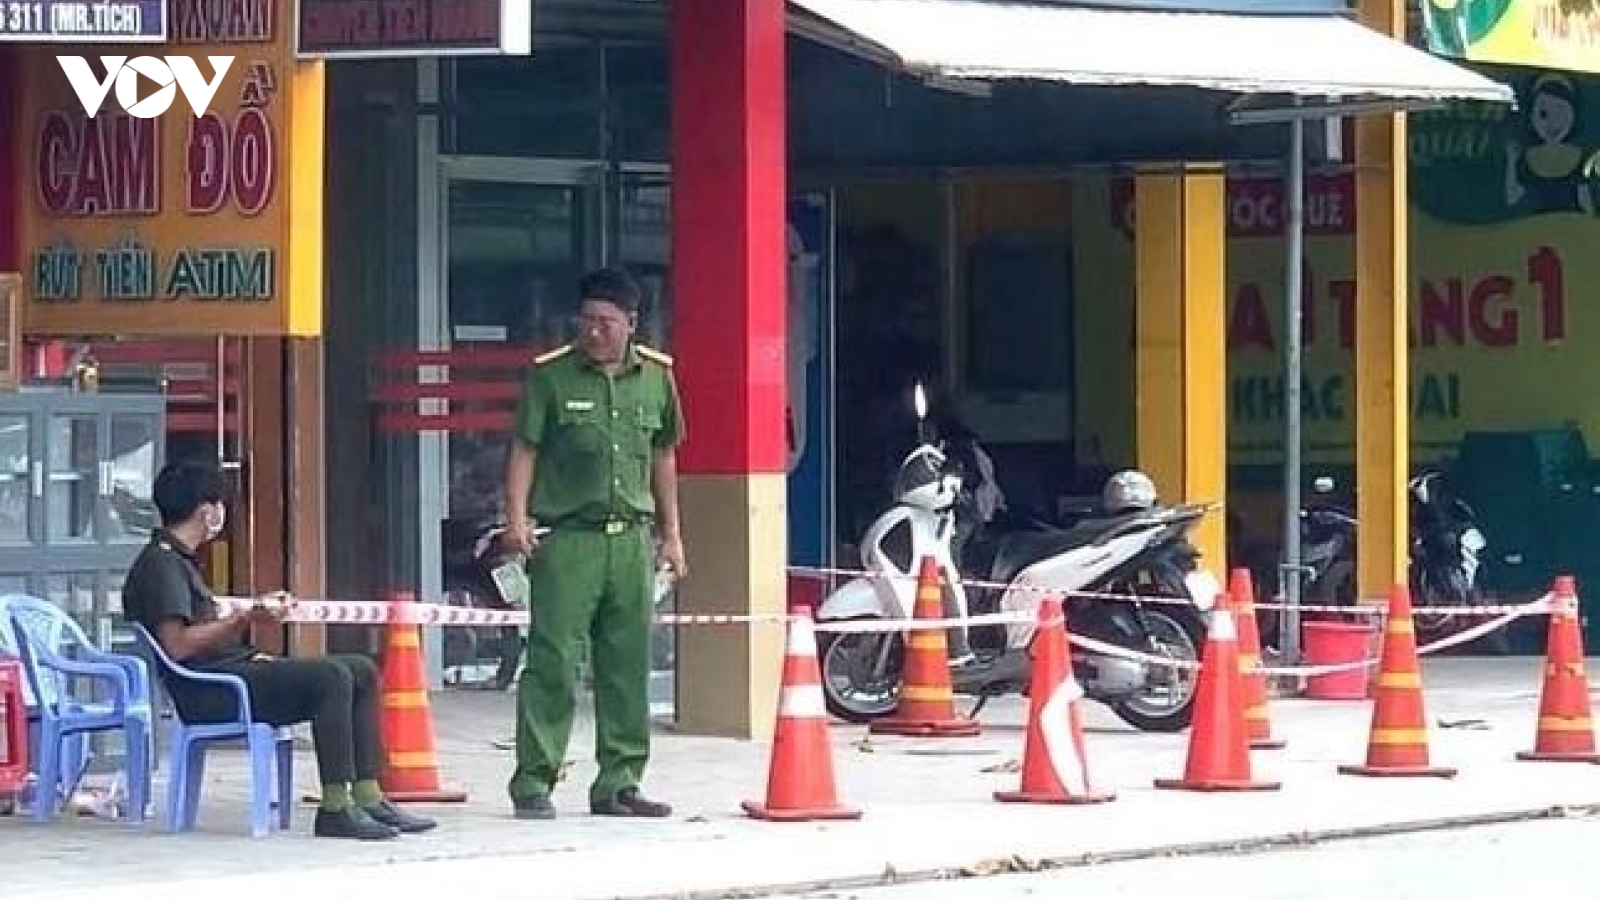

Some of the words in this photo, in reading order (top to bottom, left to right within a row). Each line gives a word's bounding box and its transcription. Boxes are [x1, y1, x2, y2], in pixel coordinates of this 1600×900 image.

[9, 3, 43, 31] 311
[165, 247, 276, 300] ATM
[1329, 272, 1520, 349] TNG
[1528, 246, 1565, 342] 1
